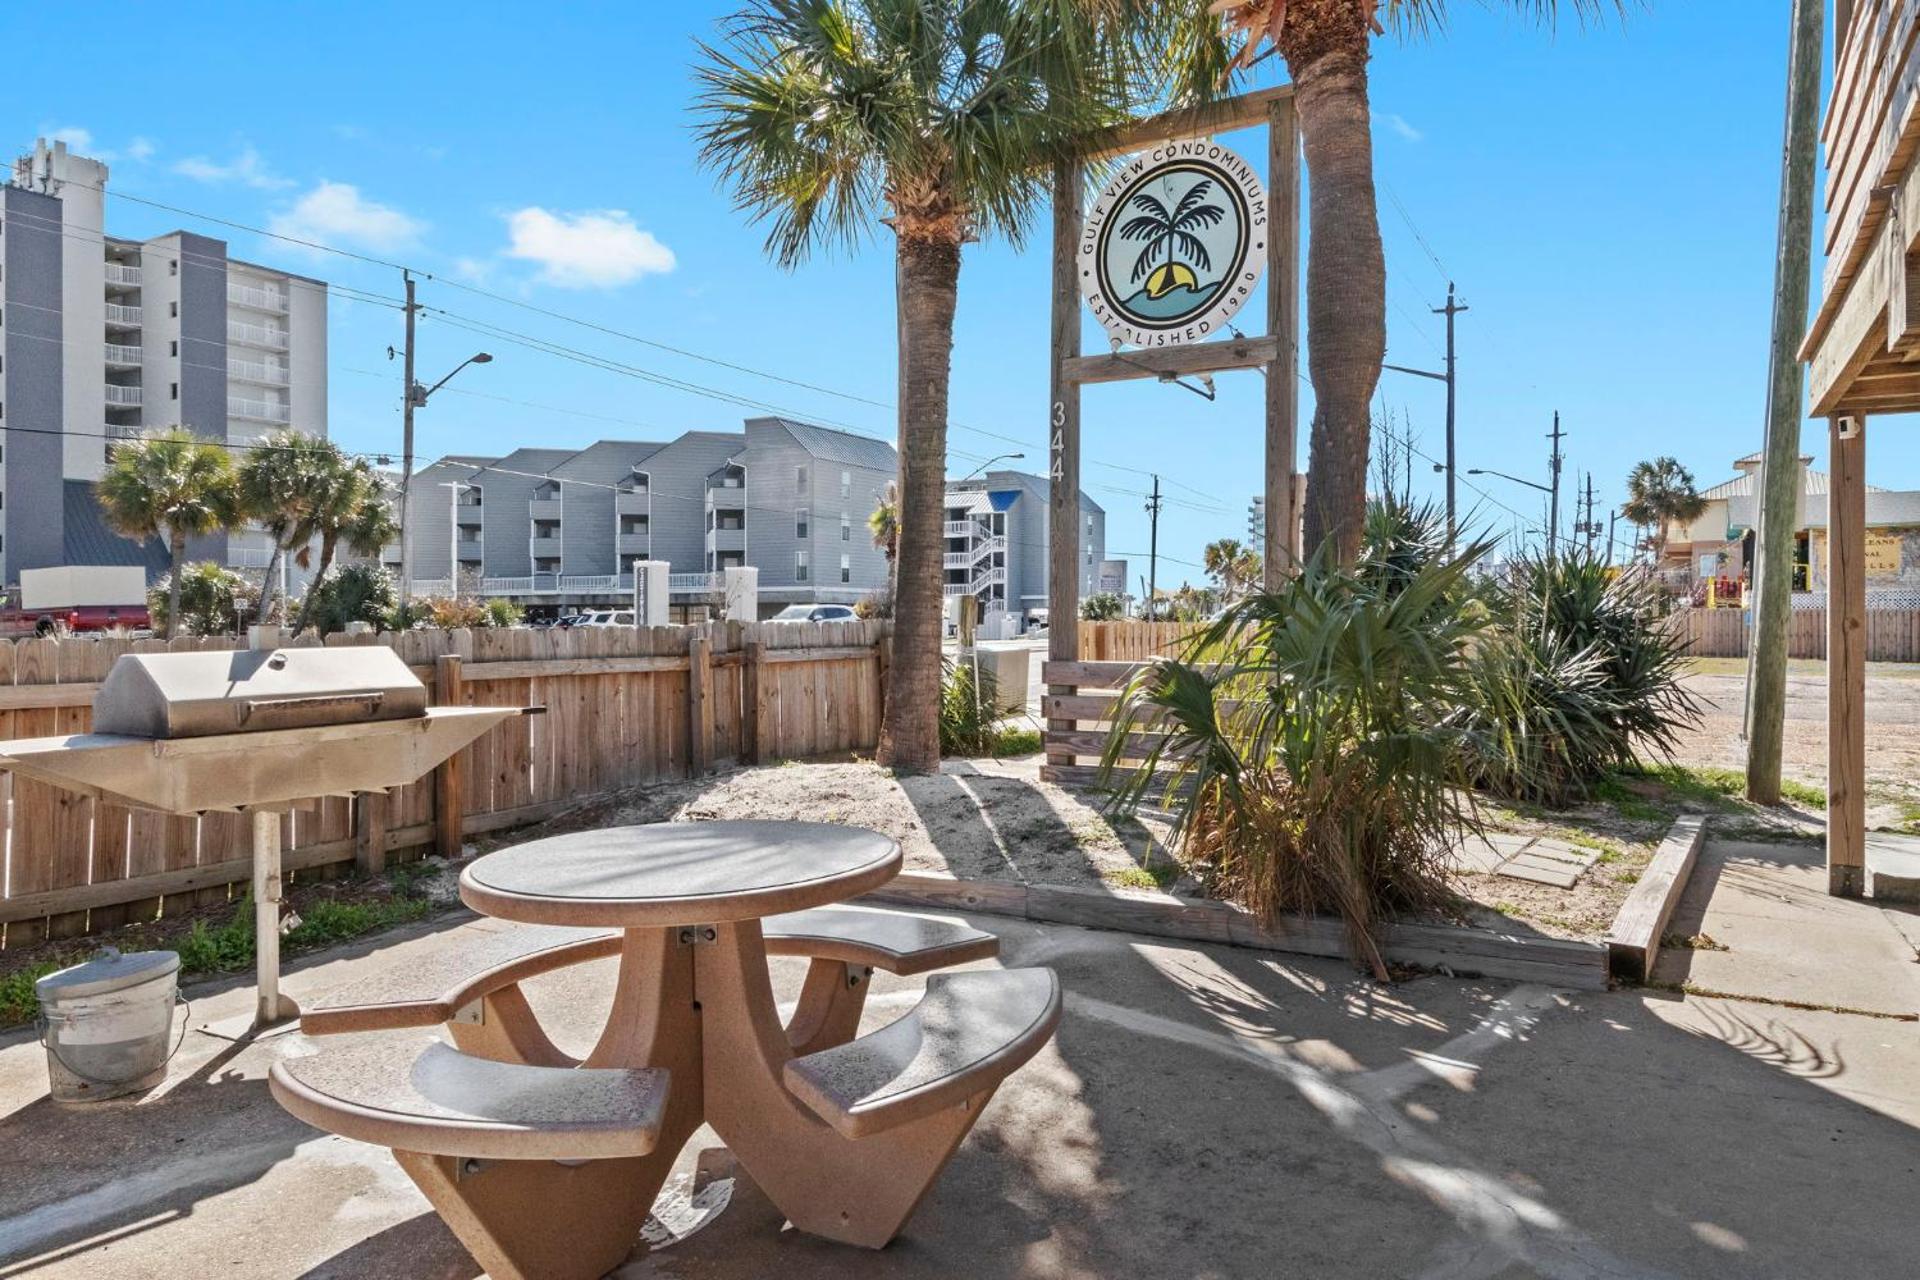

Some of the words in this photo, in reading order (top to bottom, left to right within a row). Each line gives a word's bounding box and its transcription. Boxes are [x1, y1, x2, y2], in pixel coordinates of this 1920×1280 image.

[1083, 206, 1106, 255] GULF
[1106, 159, 1145, 199] VIEW
[1152, 142, 1266, 226] CONDOMINIUMS
[1089, 293, 1210, 346] ESTLISHED
[1221, 272, 1255, 317] 1980
[1051, 401, 1066, 482] 344
